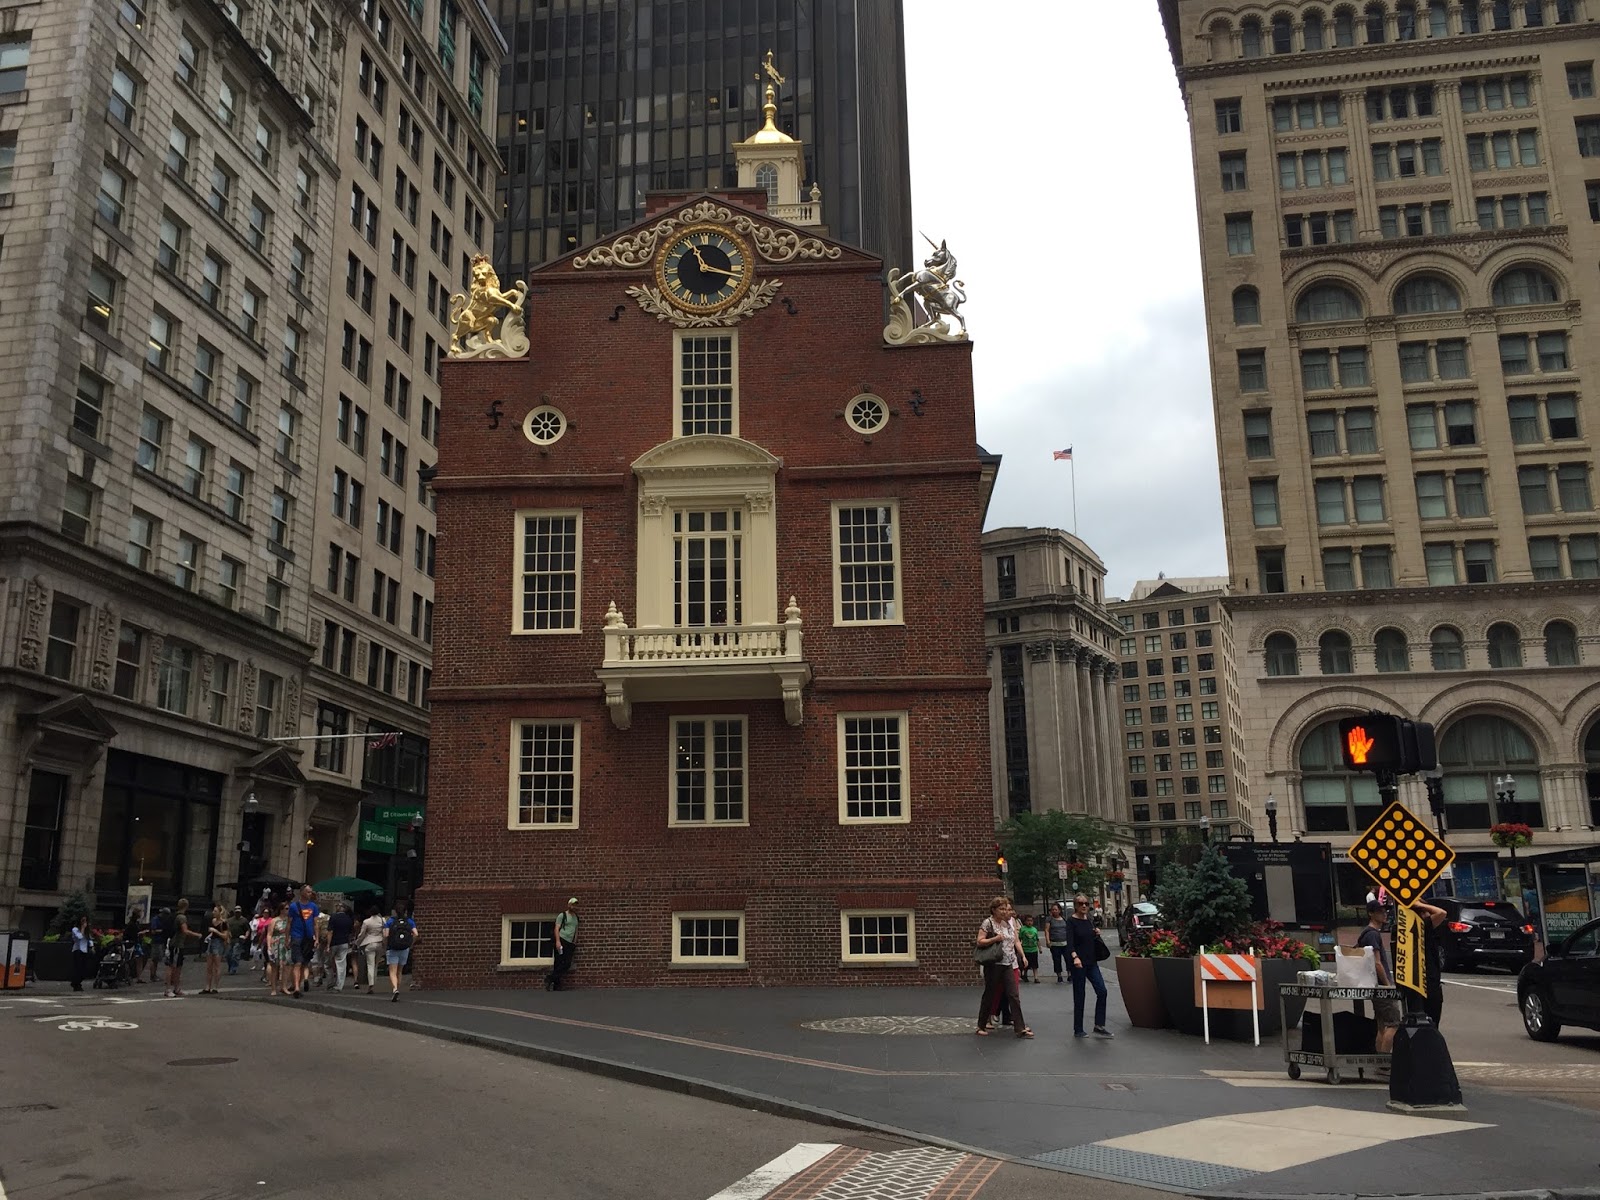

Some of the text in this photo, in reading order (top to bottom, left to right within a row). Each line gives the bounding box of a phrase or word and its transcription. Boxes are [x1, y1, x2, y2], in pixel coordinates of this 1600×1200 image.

[371, 833, 385, 842] Citizens
[1396, 909, 1407, 982] BASE CAMP
[1346, 988, 1360, 998] DELI
